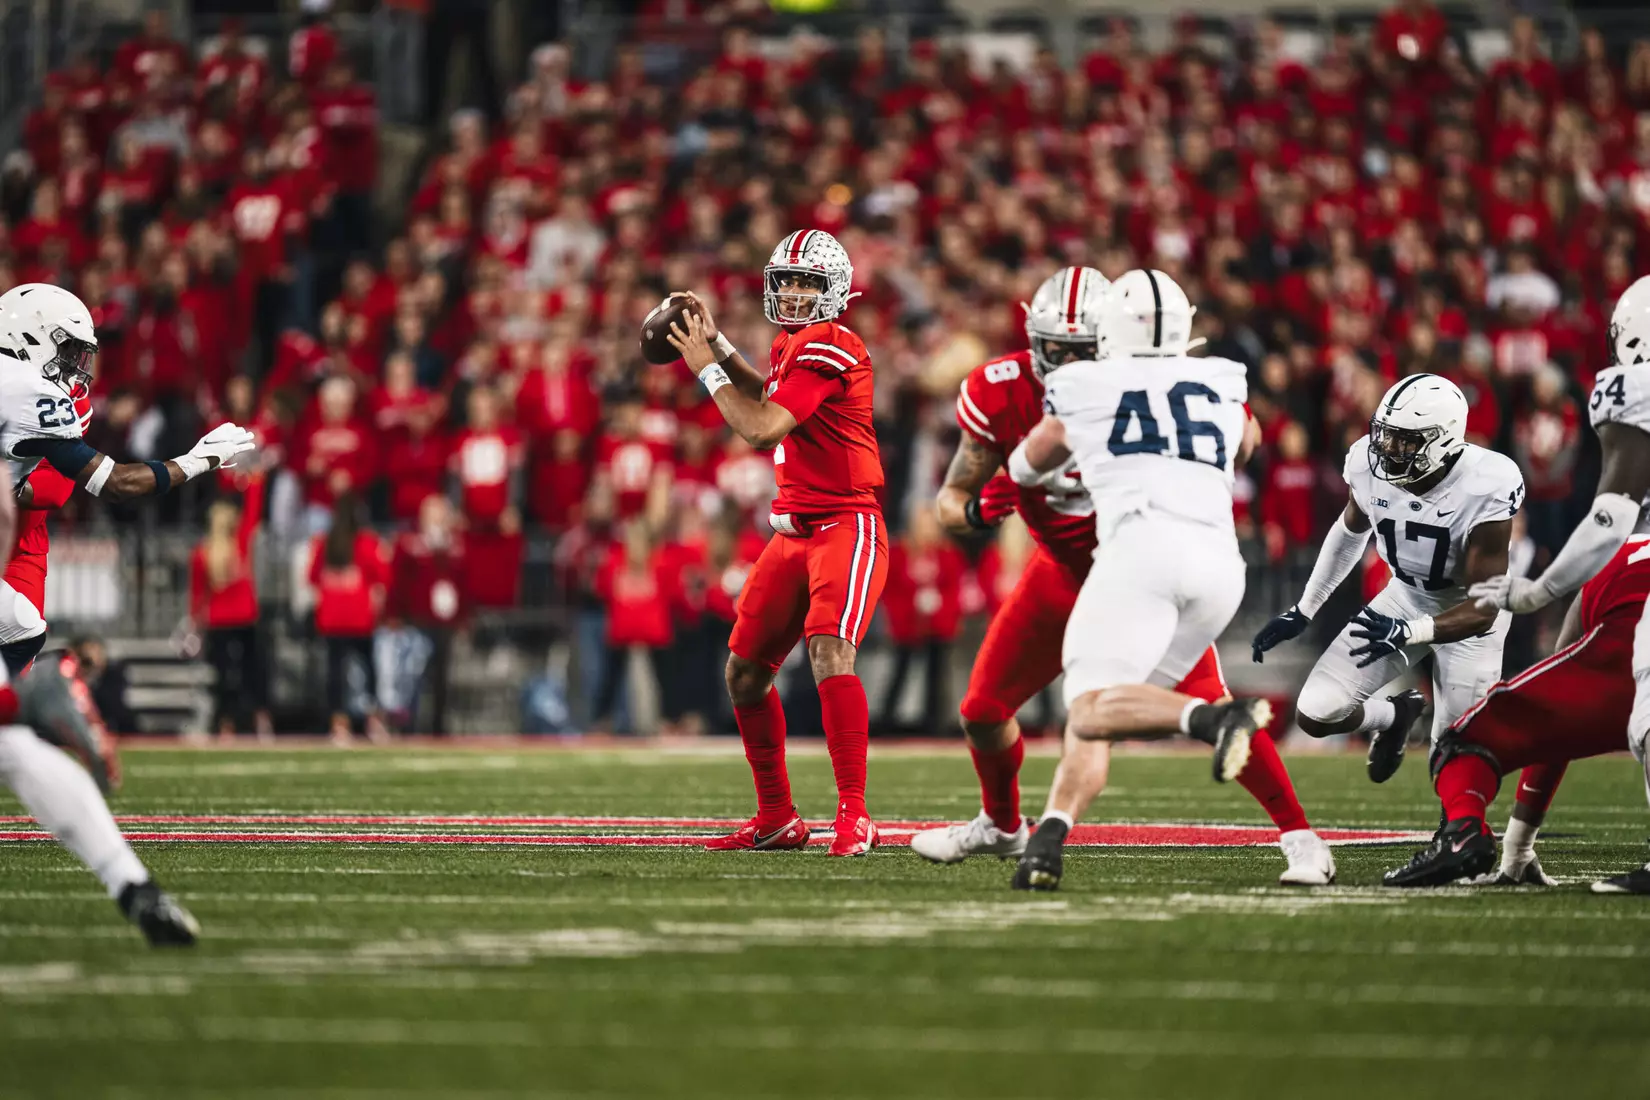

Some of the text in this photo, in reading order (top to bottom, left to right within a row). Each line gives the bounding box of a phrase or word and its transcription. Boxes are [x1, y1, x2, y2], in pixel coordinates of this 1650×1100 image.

[984, 360, 1021, 384] 8
[1591, 374, 1626, 411] 54
[36, 398, 76, 428] 23
[1107, 380, 1227, 472] 46
[1376, 517, 1454, 591] 17
